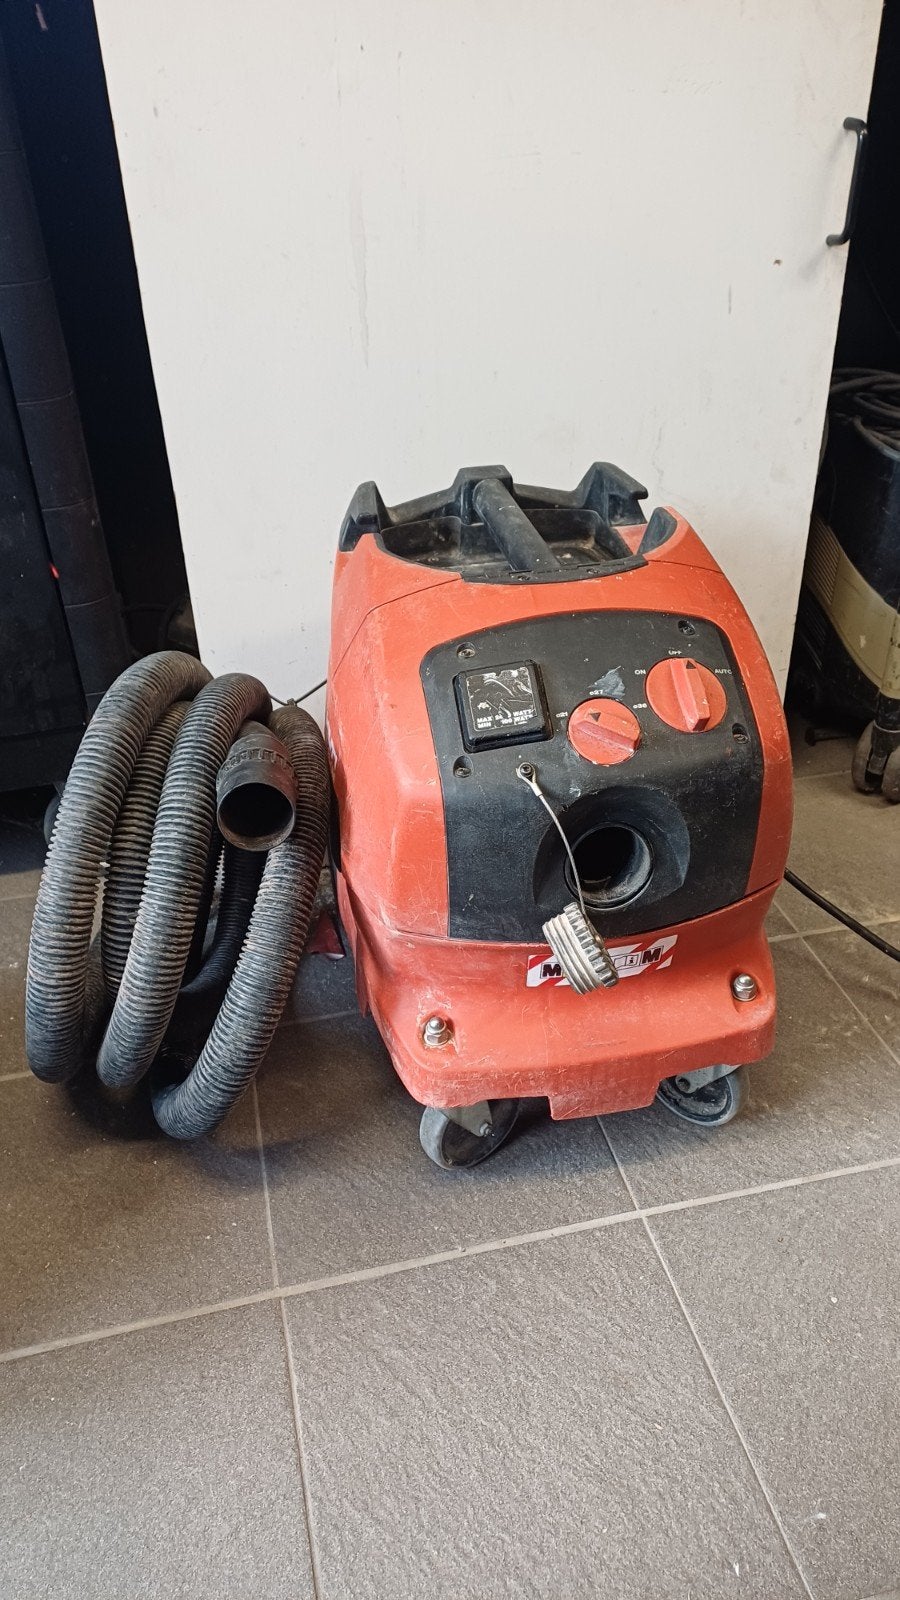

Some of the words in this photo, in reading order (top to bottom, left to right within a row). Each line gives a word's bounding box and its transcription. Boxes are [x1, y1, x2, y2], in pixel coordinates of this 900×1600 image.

[476, 721, 492, 729] MIN
[642, 947, 662, 964] M
[542, 963, 562, 977] M
